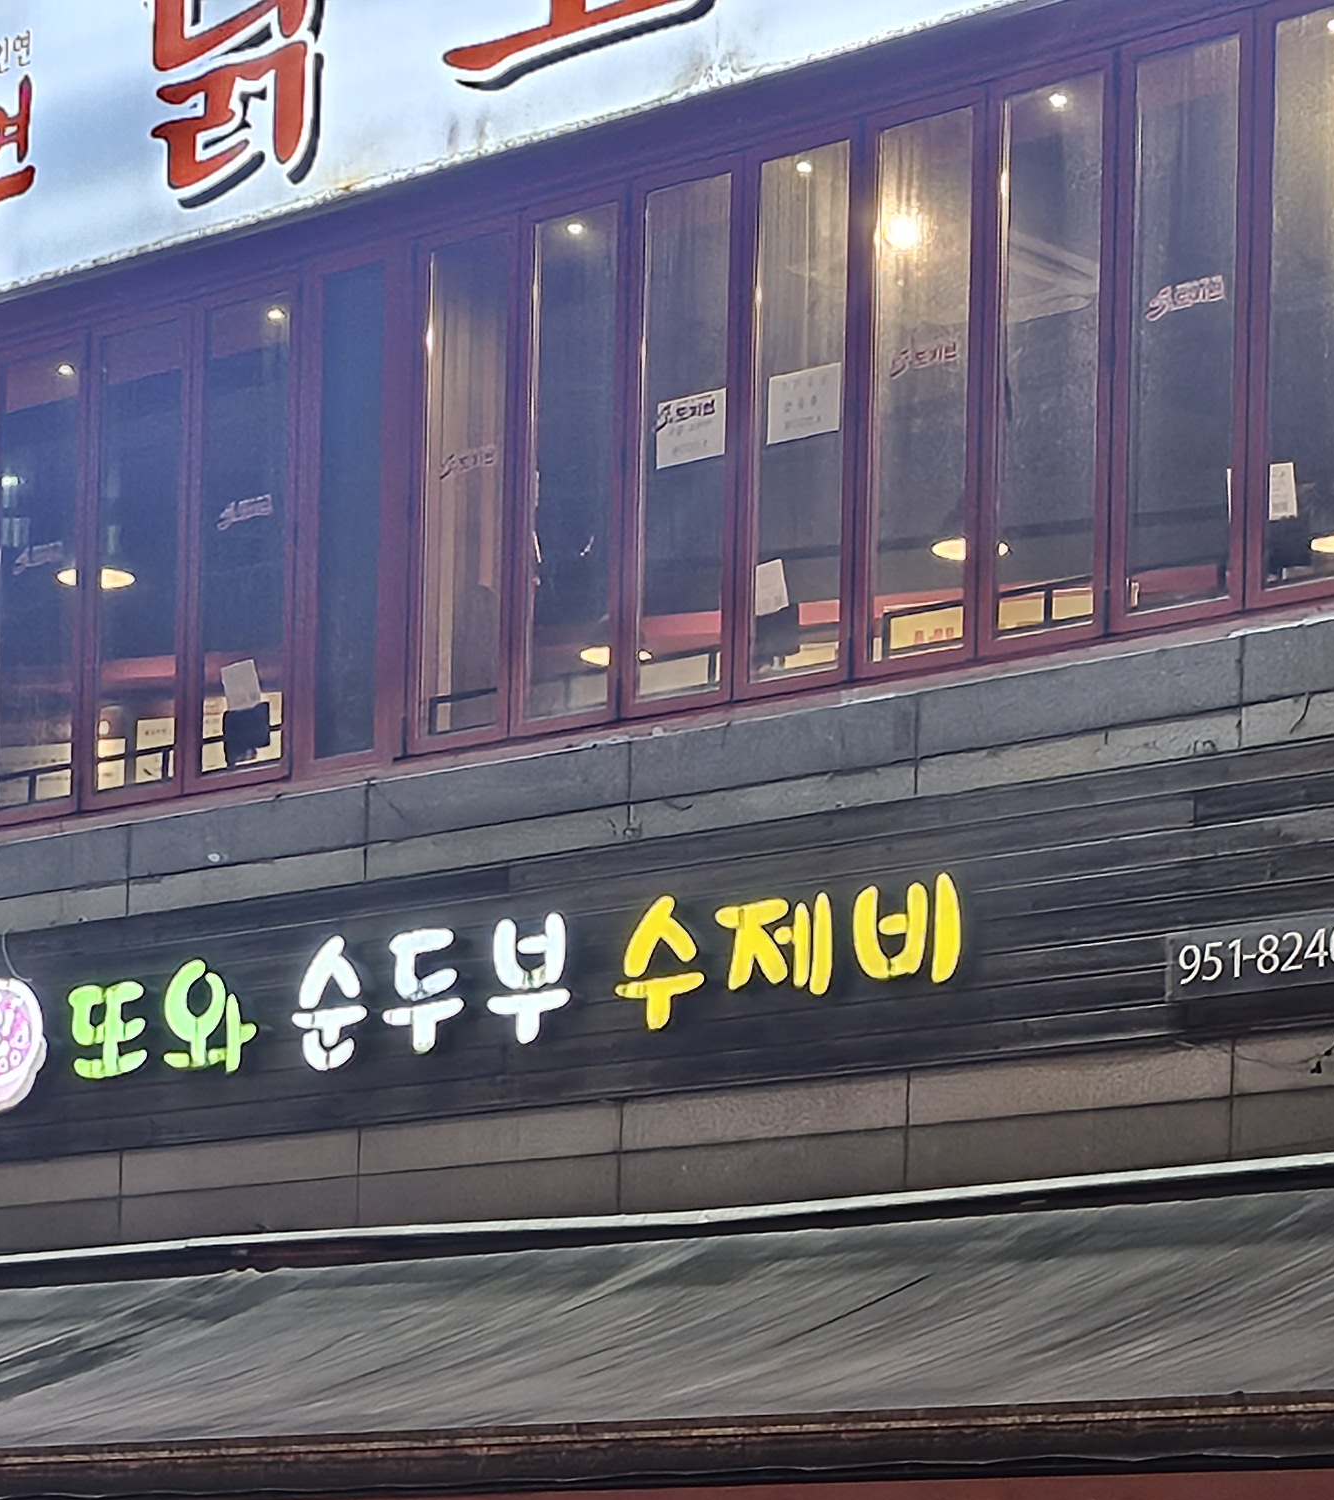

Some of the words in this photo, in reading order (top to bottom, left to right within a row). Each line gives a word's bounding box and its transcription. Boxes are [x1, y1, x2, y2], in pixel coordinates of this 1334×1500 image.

[68, 958, 258, 1080] 또와
[289, 911, 573, 1072] 순두부
[615, 872, 964, 1031] 수제비
